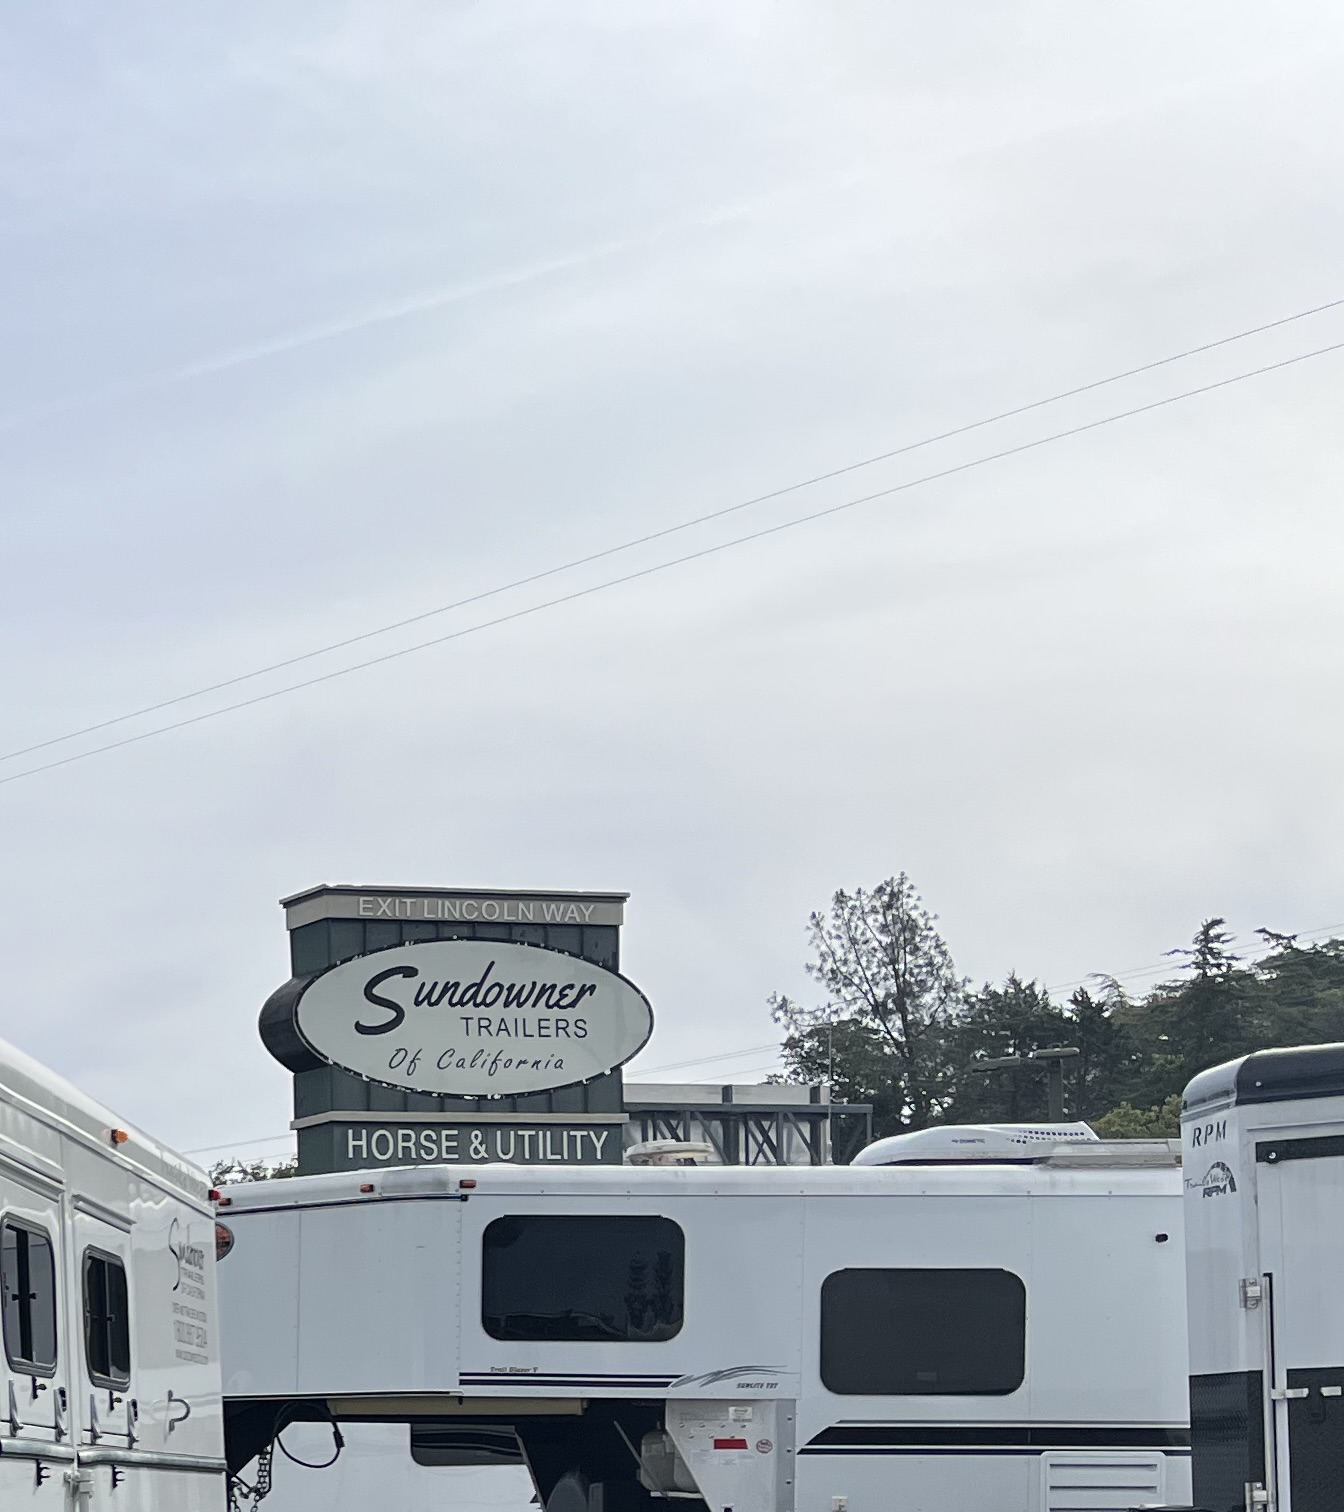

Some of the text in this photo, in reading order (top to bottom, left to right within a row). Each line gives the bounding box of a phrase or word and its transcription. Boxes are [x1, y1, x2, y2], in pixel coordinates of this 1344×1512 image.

[359, 897, 595, 923] EXIT LINCOLN WAY
[354, 961, 597, 1036] Sundowner
[460, 1016, 589, 1039] TRAILERS
[388, 1048, 564, 1077] Of California
[347, 1128, 609, 1160] HORSE & UTILITY
[1192, 1120, 1227, 1149] RPM
